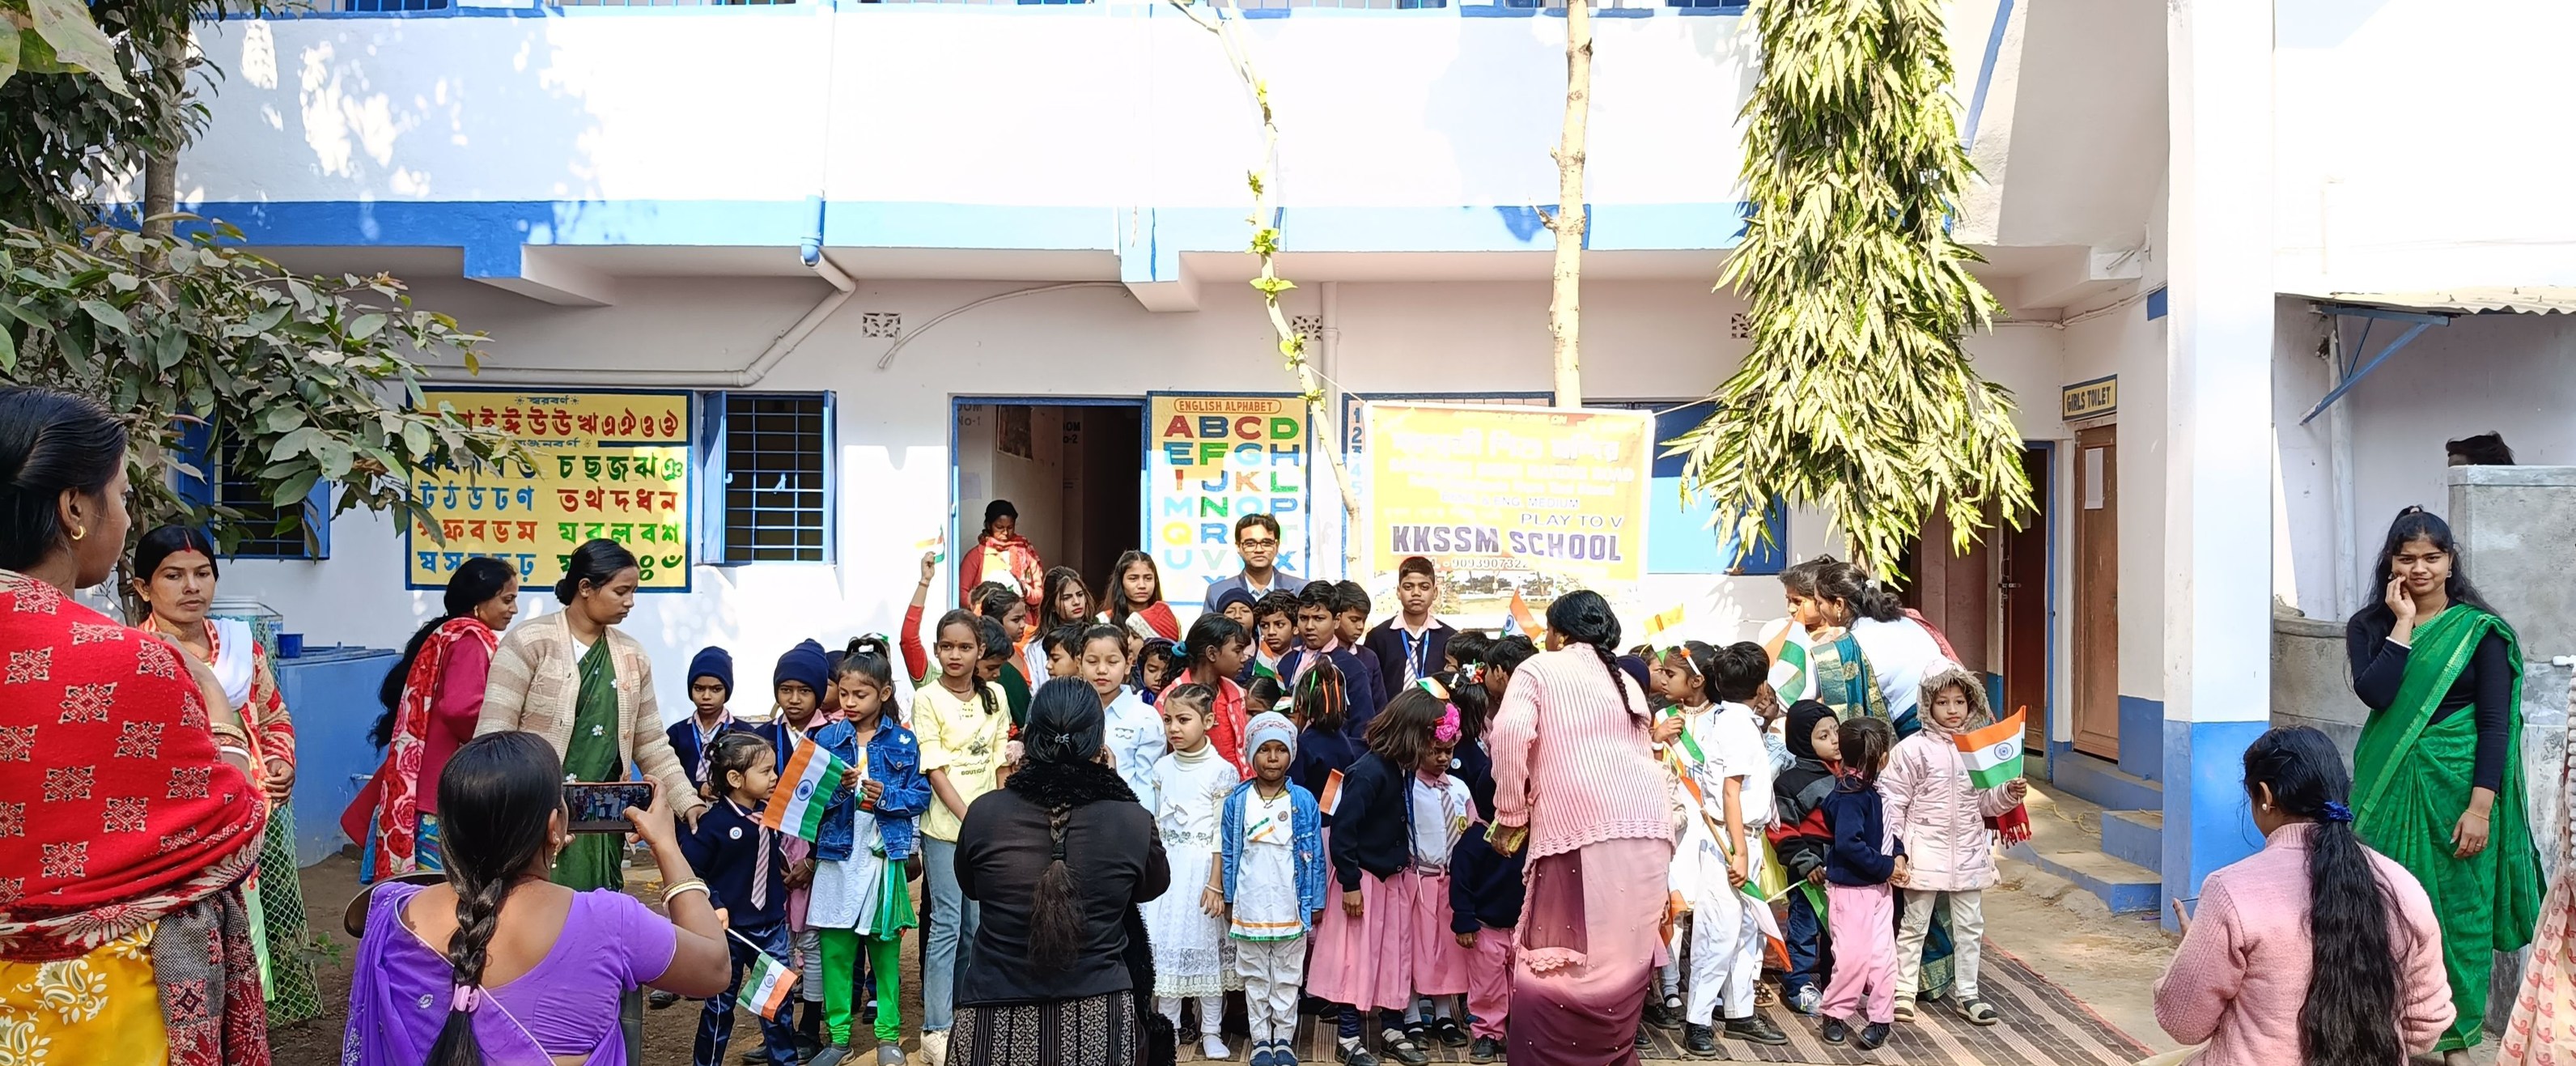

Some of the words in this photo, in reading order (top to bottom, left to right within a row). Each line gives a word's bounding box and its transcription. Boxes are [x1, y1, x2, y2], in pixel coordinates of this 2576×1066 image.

[1179, 401, 1222, 411] ENGLISH
[1225, 401, 1273, 412] ALPHABET
[2067, 392, 2085, 412] GIRLS
[2087, 386, 2111, 408] TOILET
[1353, 407, 1360, 423] 1
[1164, 415, 1194, 438] A
[1199, 416, 1229, 438] B
[1234, 416, 1262, 440] C
[1270, 417, 1299, 440] D
[1352, 427, 1362, 444] 2
[1163, 441, 1194, 465] E
[1199, 442, 1229, 465] F
[1234, 442, 1263, 465] G
[1270, 444, 1300, 466] H
[1175, 469, 1183, 491] I
[1201, 470, 1228, 492] J
[1236, 471, 1261, 491] K
[1271, 471, 1298, 492] L
[1164, 496, 1193, 516] M
[1201, 496, 1228, 517] N
[1236, 496, 1263, 515] O
[1271, 498, 1297, 518] P
[1528, 498, 1578, 508] MEDIUM
[1521, 514, 1571, 525] PLAY
[1580, 516, 1602, 527] TO
[1611, 516, 1622, 528] V
[1162, 522, 1192, 545] Q
[1201, 524, 1228, 544] R
[1393, 526, 1499, 552] KKSSM
[1509, 531, 1621, 561] SCHOOL
[1165, 549, 1192, 570] U
[1201, 550, 1228, 570] V
[1275, 551, 1296, 571] X
[961, 767, 986, 775] BOUTIQ
